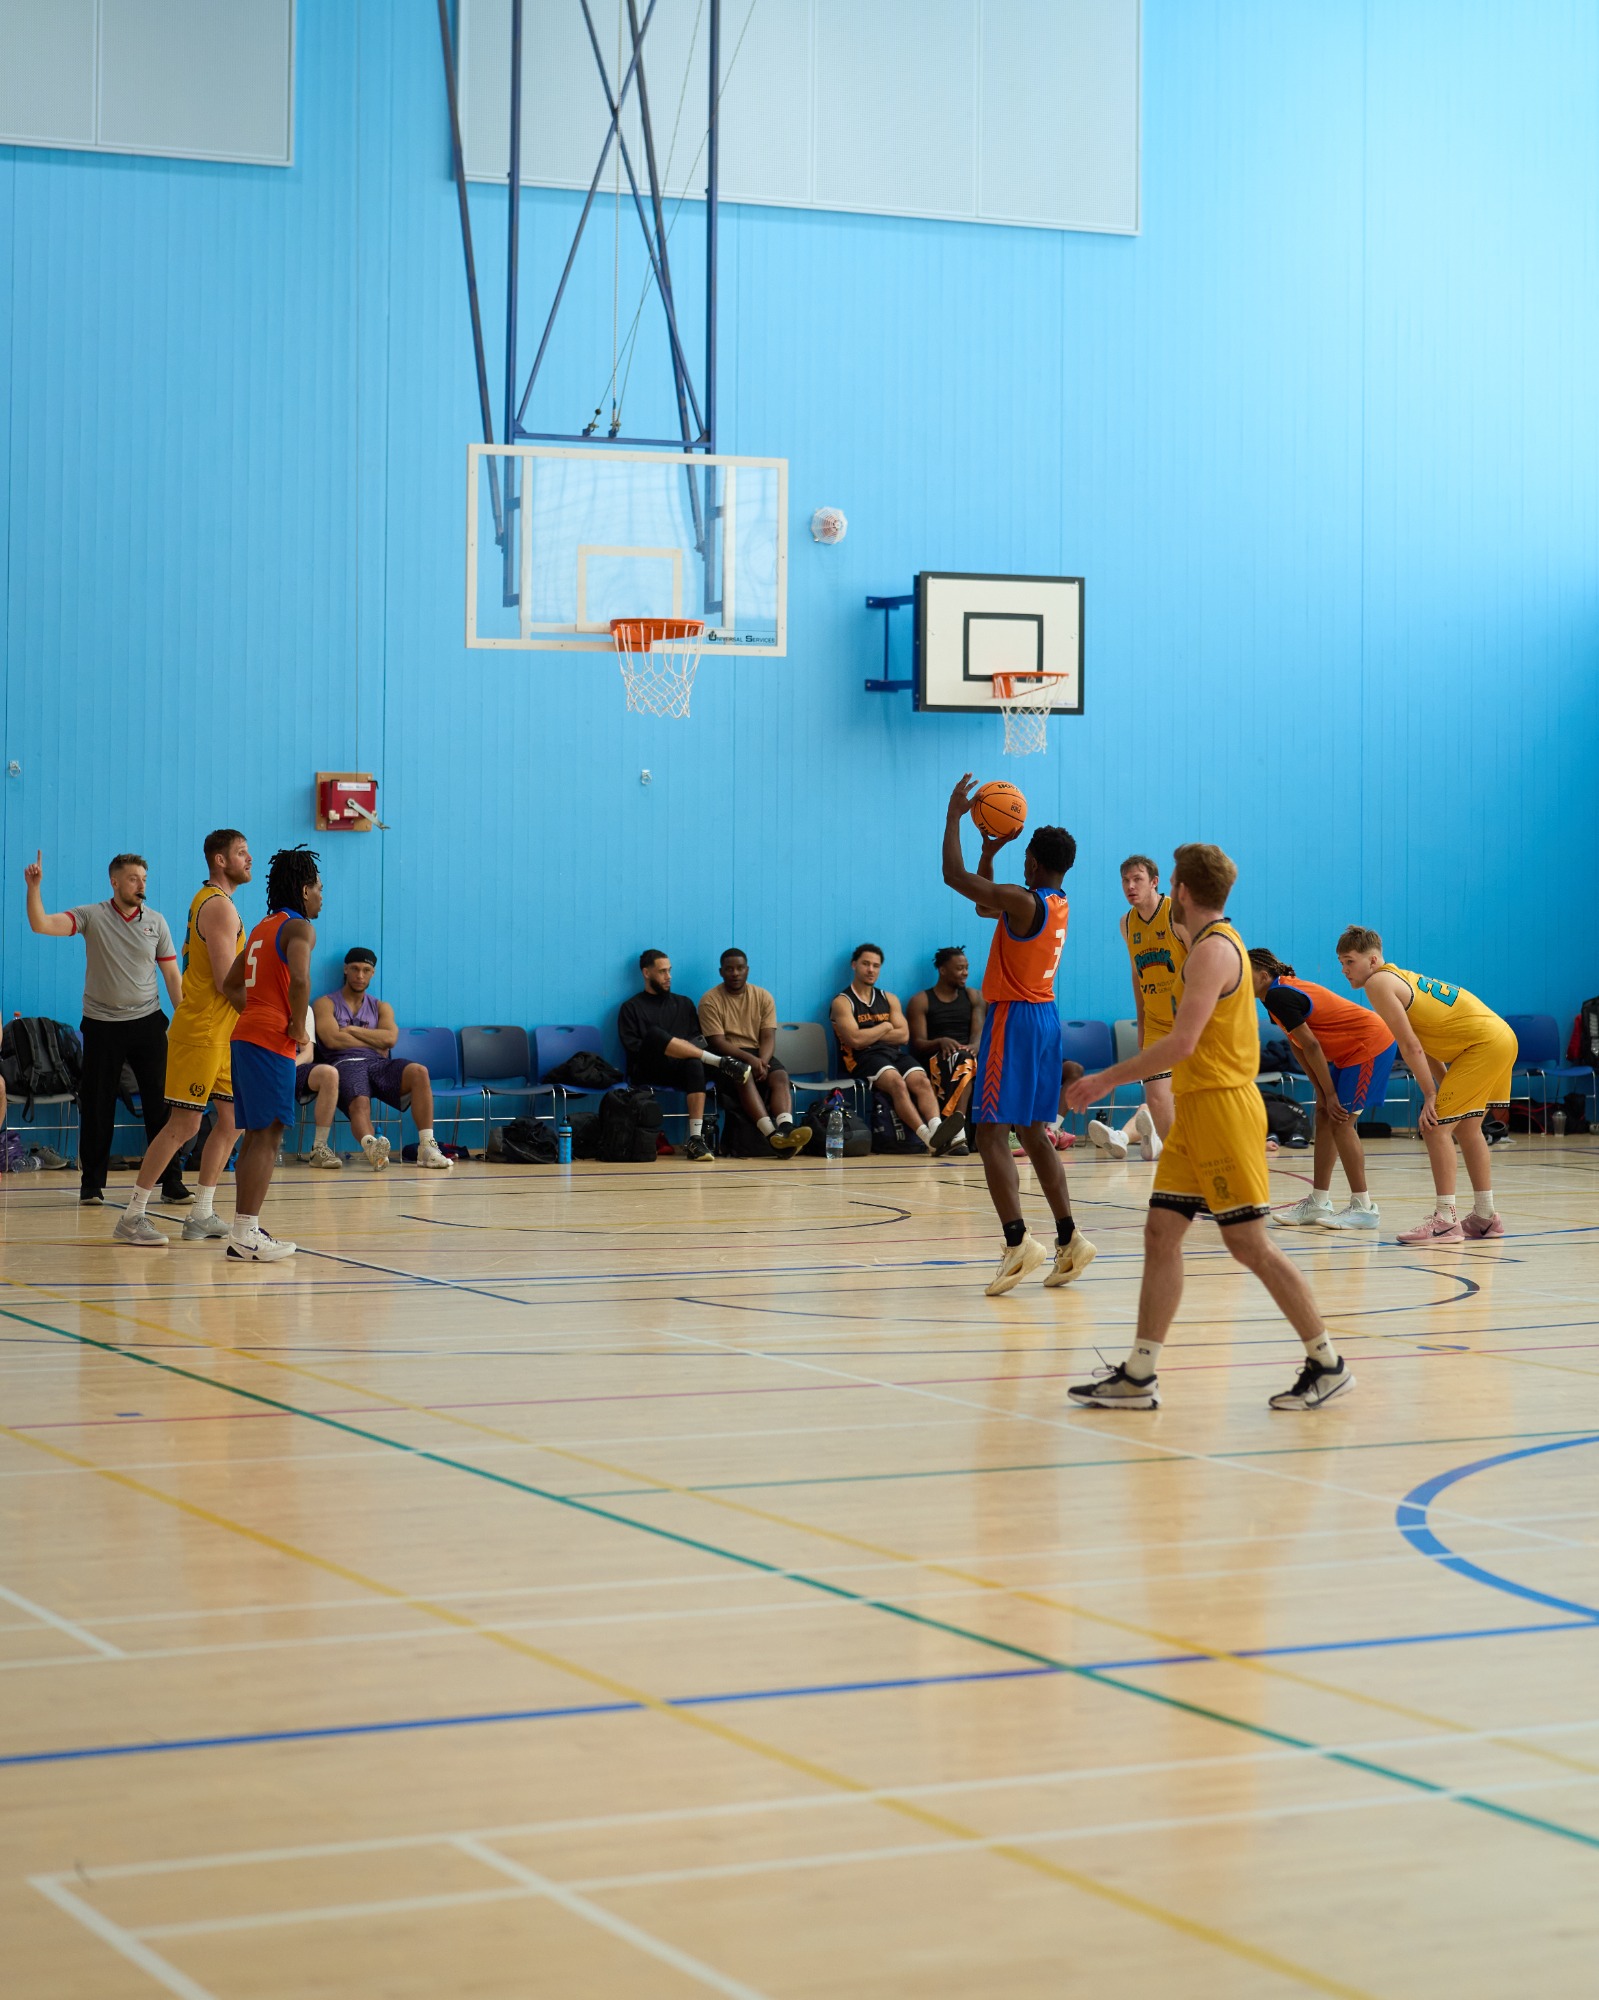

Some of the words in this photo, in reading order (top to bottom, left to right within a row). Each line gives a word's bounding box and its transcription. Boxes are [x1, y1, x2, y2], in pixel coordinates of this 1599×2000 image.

[1043, 928, 1066, 979] 3
[1133, 931, 1142, 945] 13
[244, 939, 263, 988] 5
[194, 1084, 203, 1092] 15
